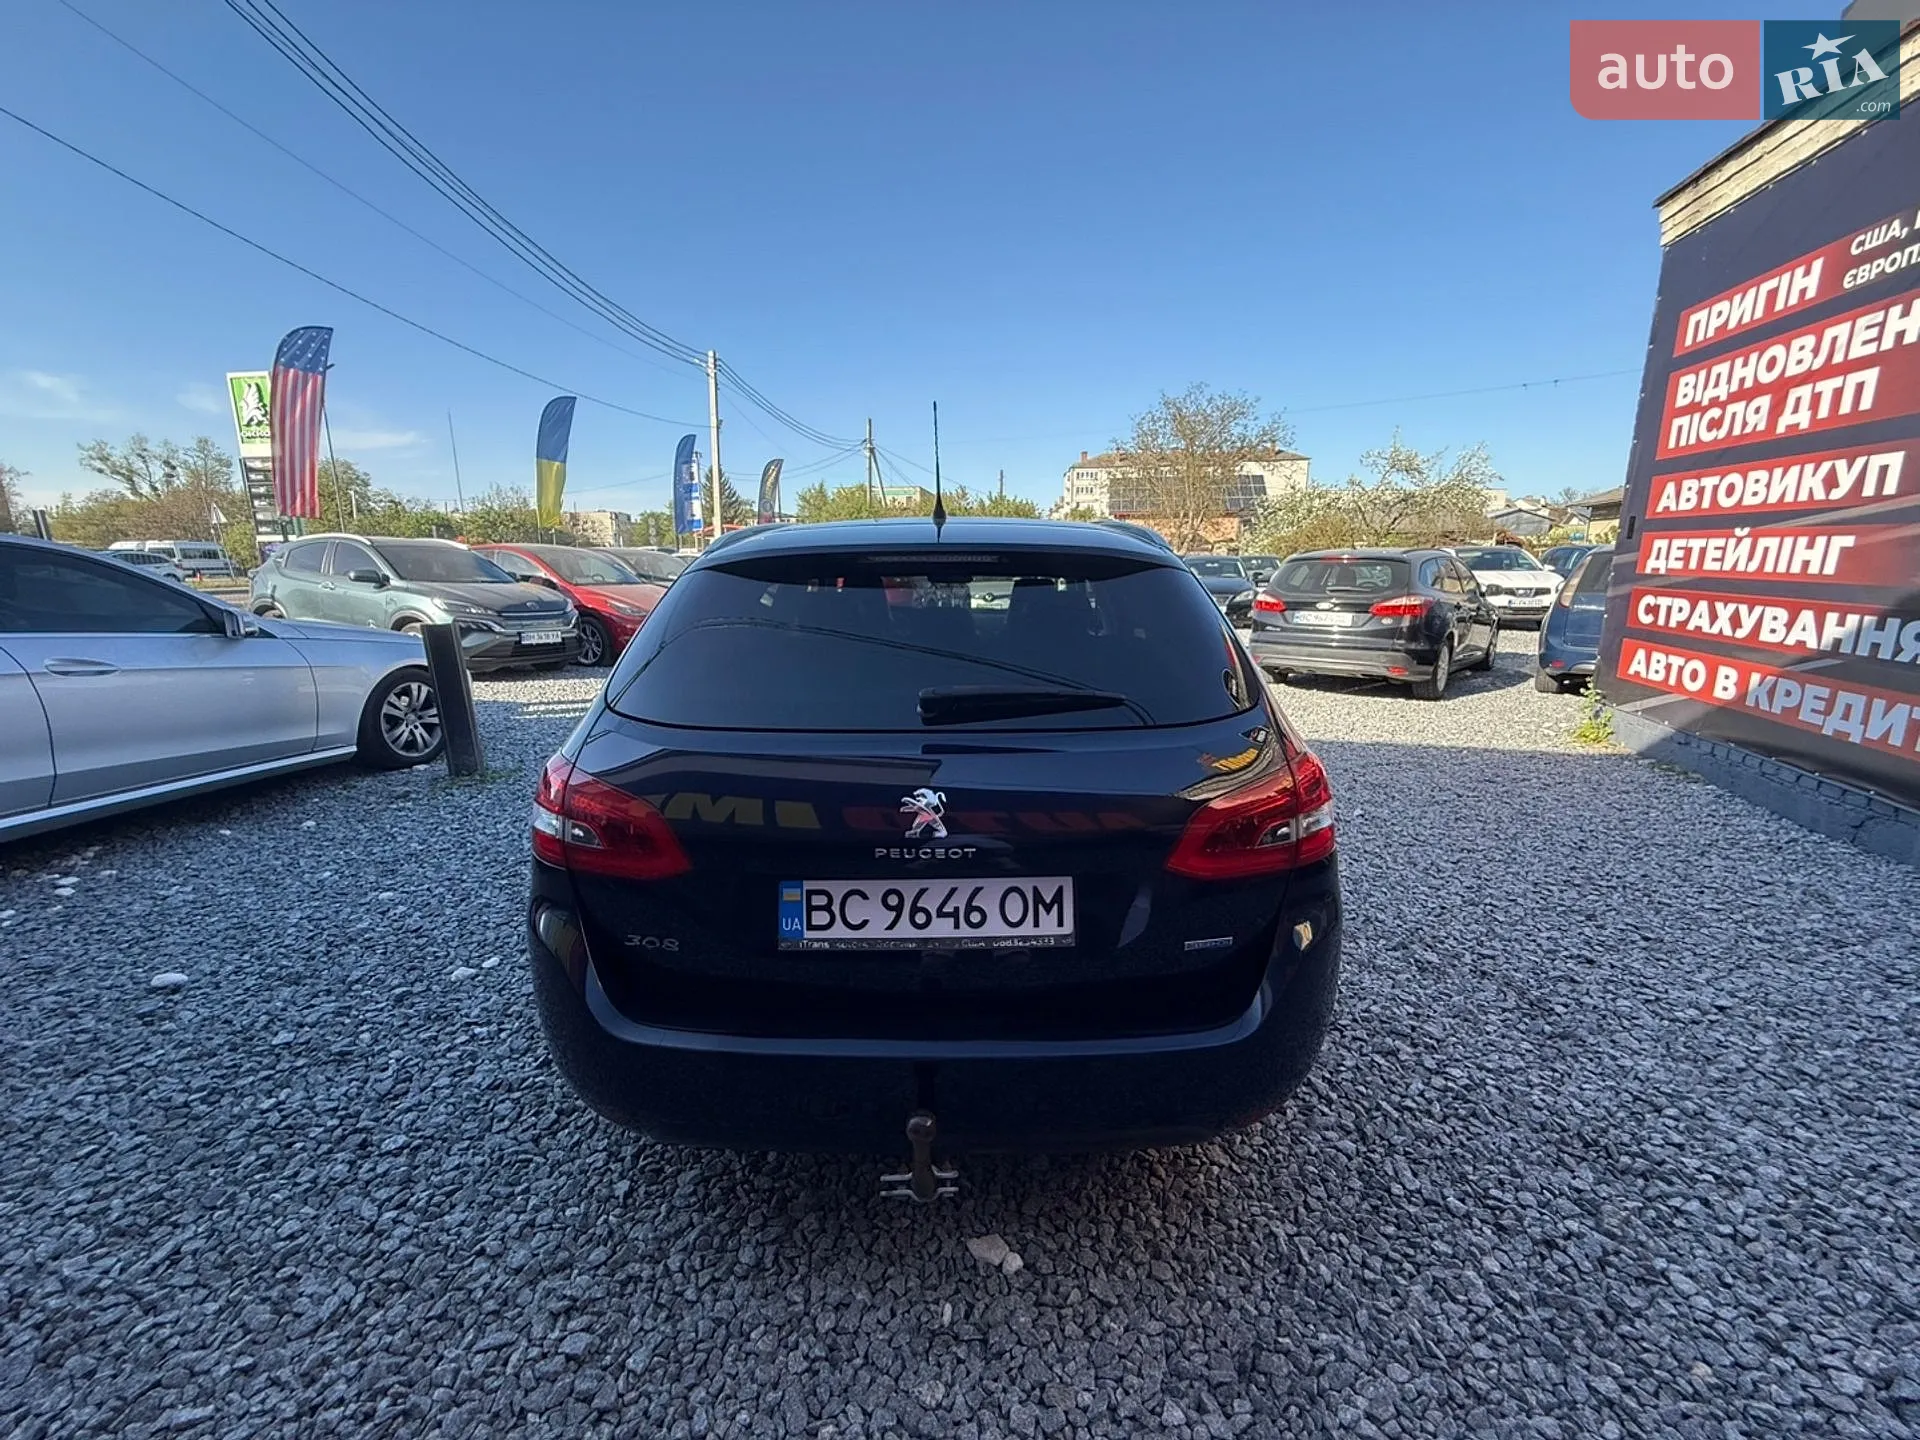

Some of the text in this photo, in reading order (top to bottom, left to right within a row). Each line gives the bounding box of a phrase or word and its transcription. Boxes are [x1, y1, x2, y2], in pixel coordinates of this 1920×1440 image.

[1850, 218, 1909, 255] США,
[1843, 242, 1920, 289] ЄВРОП
[1684, 256, 1824, 347] ПРИГІН
[1674, 297, 1920, 409] ВІДНОВЛЕН
[1668, 366, 1880, 450] ПІСЛЯ ДТП
[1655, 451, 1905, 512] АВТОВИКУП
[1645, 527, 1856, 575] ДЕТЕЙЛІНГ
[1637, 594, 1920, 664] СТРАХУВАННЯ
[1627, 648, 1920, 752] АВТО В КРЕДИ
[875, 848, 977, 859] PEUGEOT
[782, 885, 1064, 931] UA BC 9646 OM
[624, 934, 680, 951] 308
